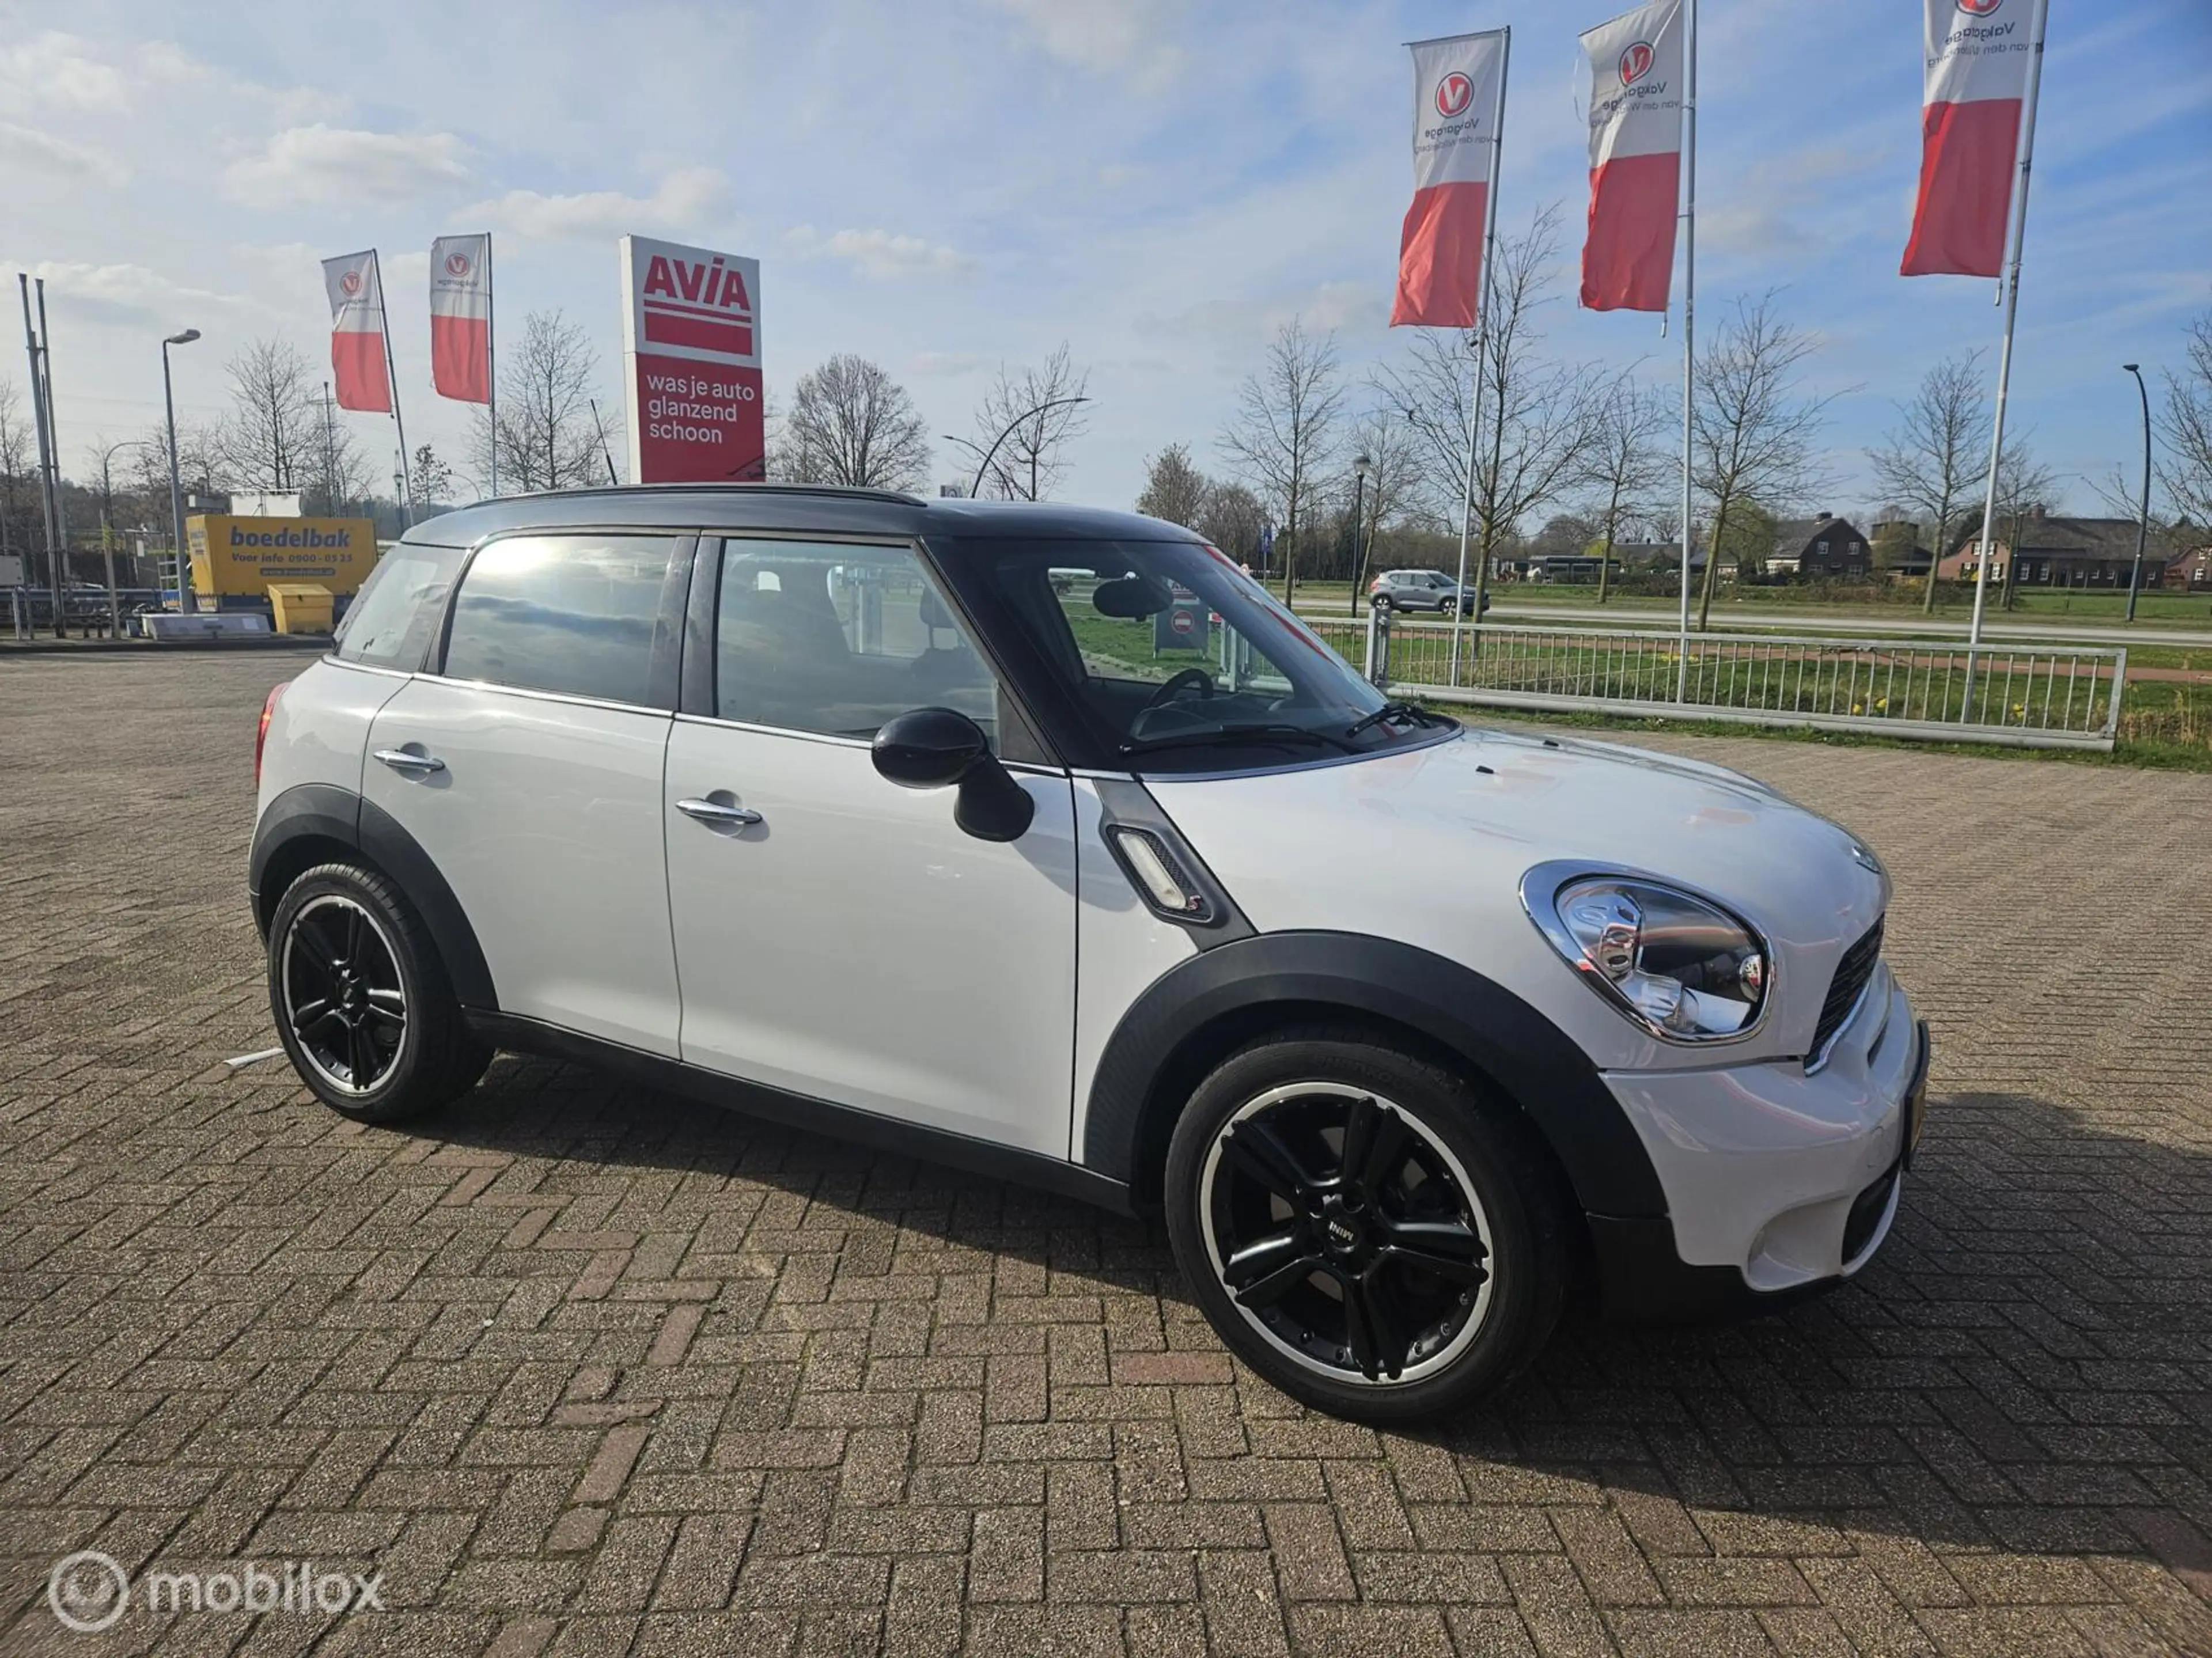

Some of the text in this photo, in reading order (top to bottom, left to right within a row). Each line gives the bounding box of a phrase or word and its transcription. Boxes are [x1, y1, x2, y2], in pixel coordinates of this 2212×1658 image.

[647, 375, 755, 401] was je auto
[649, 395, 737, 422] glanzend
[649, 420, 722, 444] schoon
[230, 526, 349, 547] boedelbak
[232, 553, 258, 561] Voor
[262, 552, 284, 563] info
